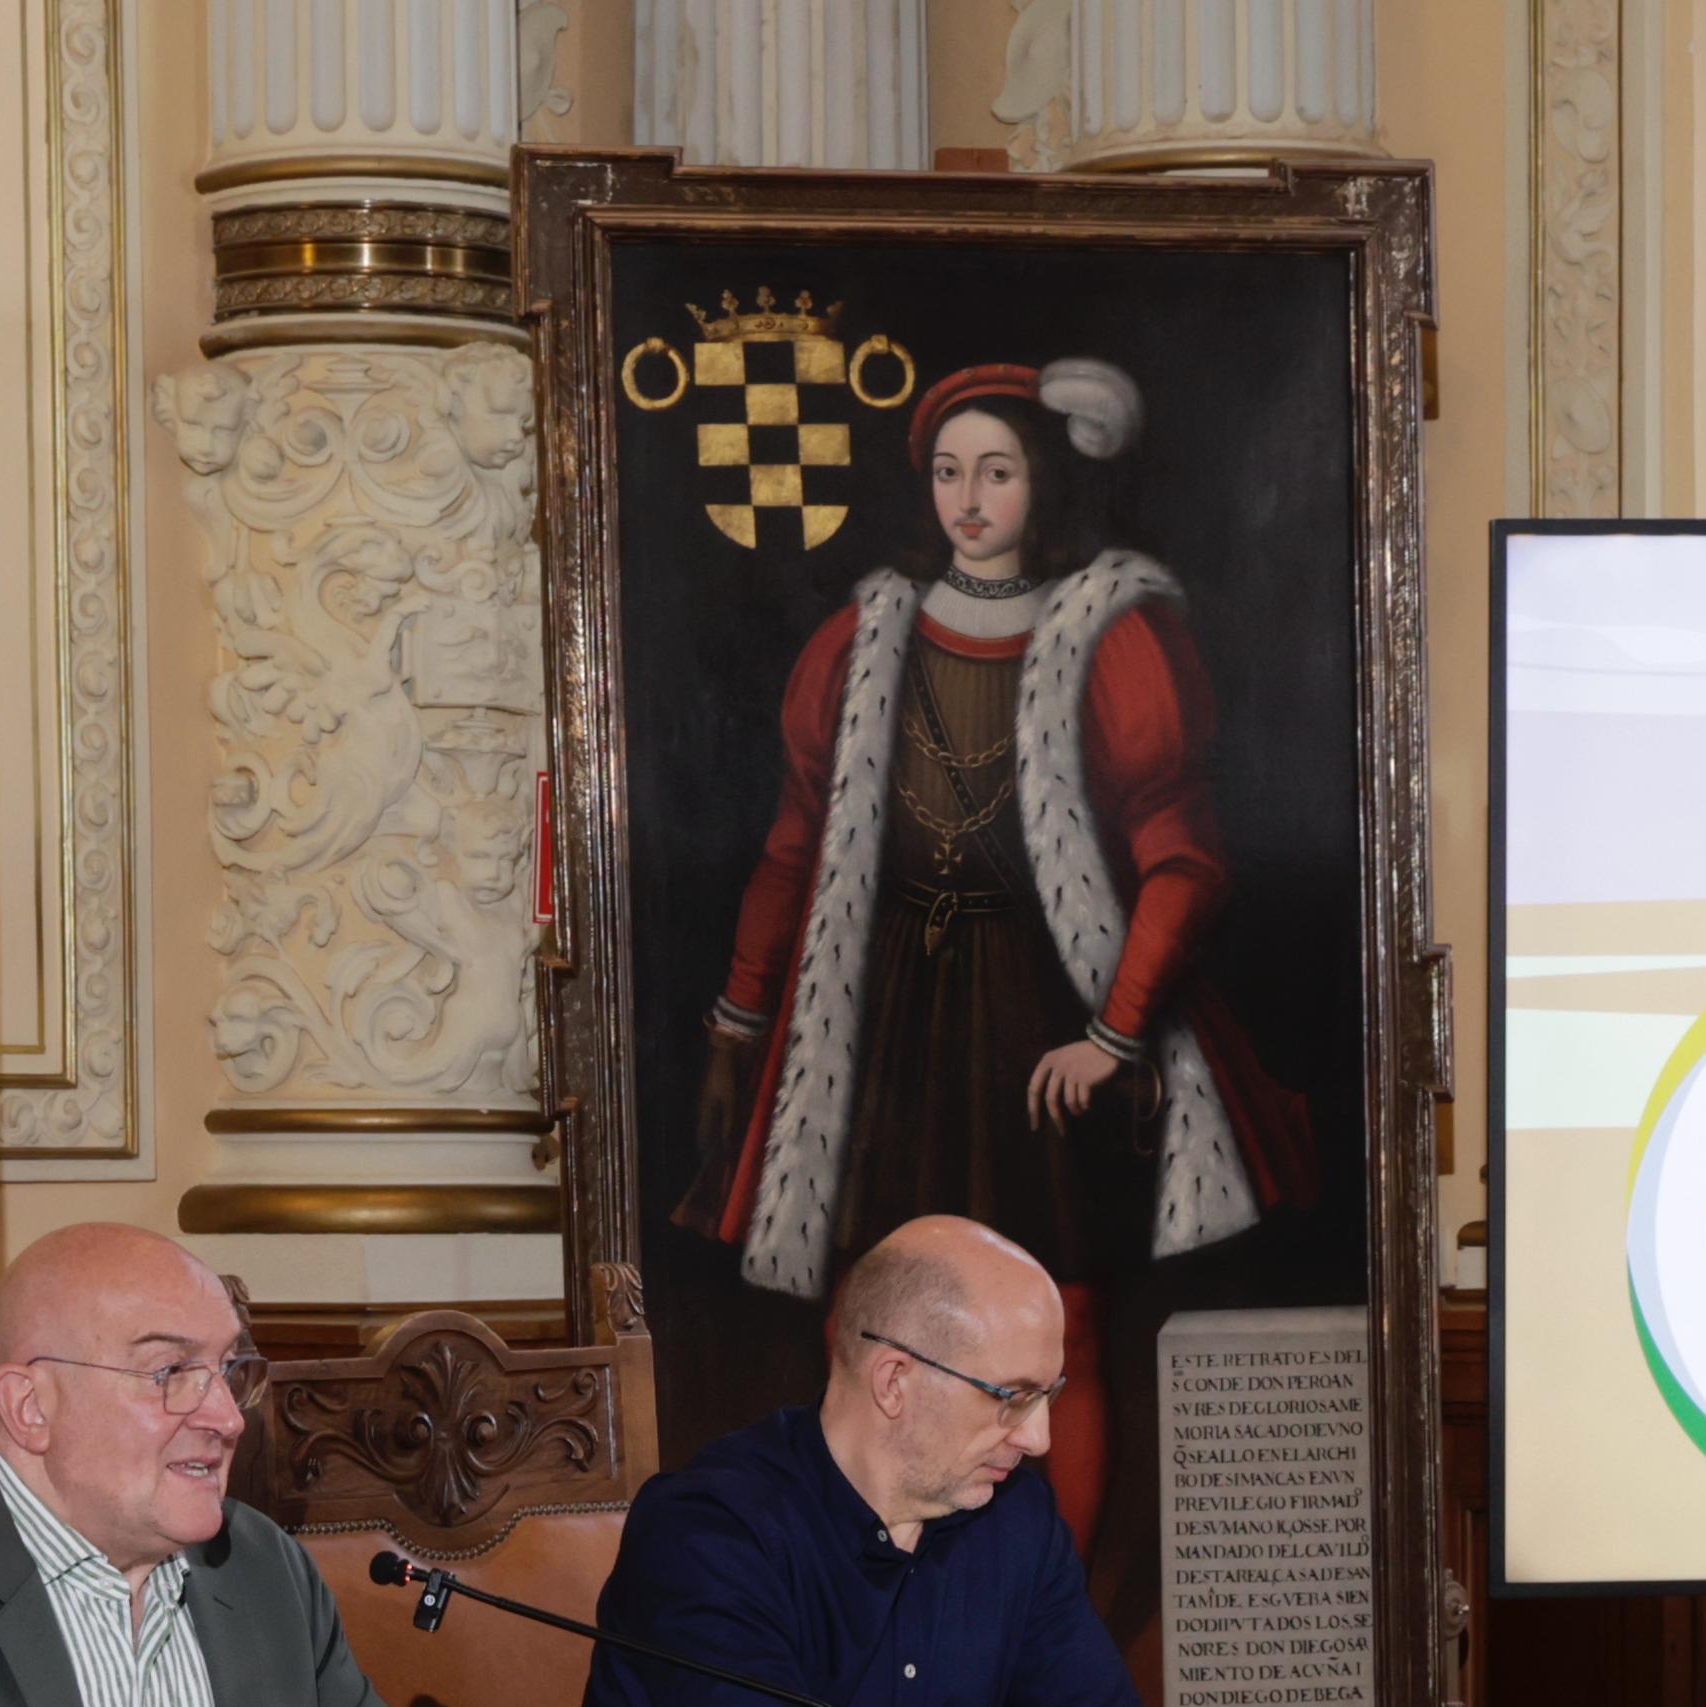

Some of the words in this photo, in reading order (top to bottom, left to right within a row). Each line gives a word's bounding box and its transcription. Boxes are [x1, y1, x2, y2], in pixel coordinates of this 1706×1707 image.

[1172, 1354, 1217, 1368] ESTE
[1224, 1352, 1305, 1366] RETRATO
[1184, 1377, 1243, 1391] CONDE
[1248, 1376, 1283, 1390] DON
[1246, 1640, 1285, 1655] DON
[1259, 1665, 1286, 1680] DE
